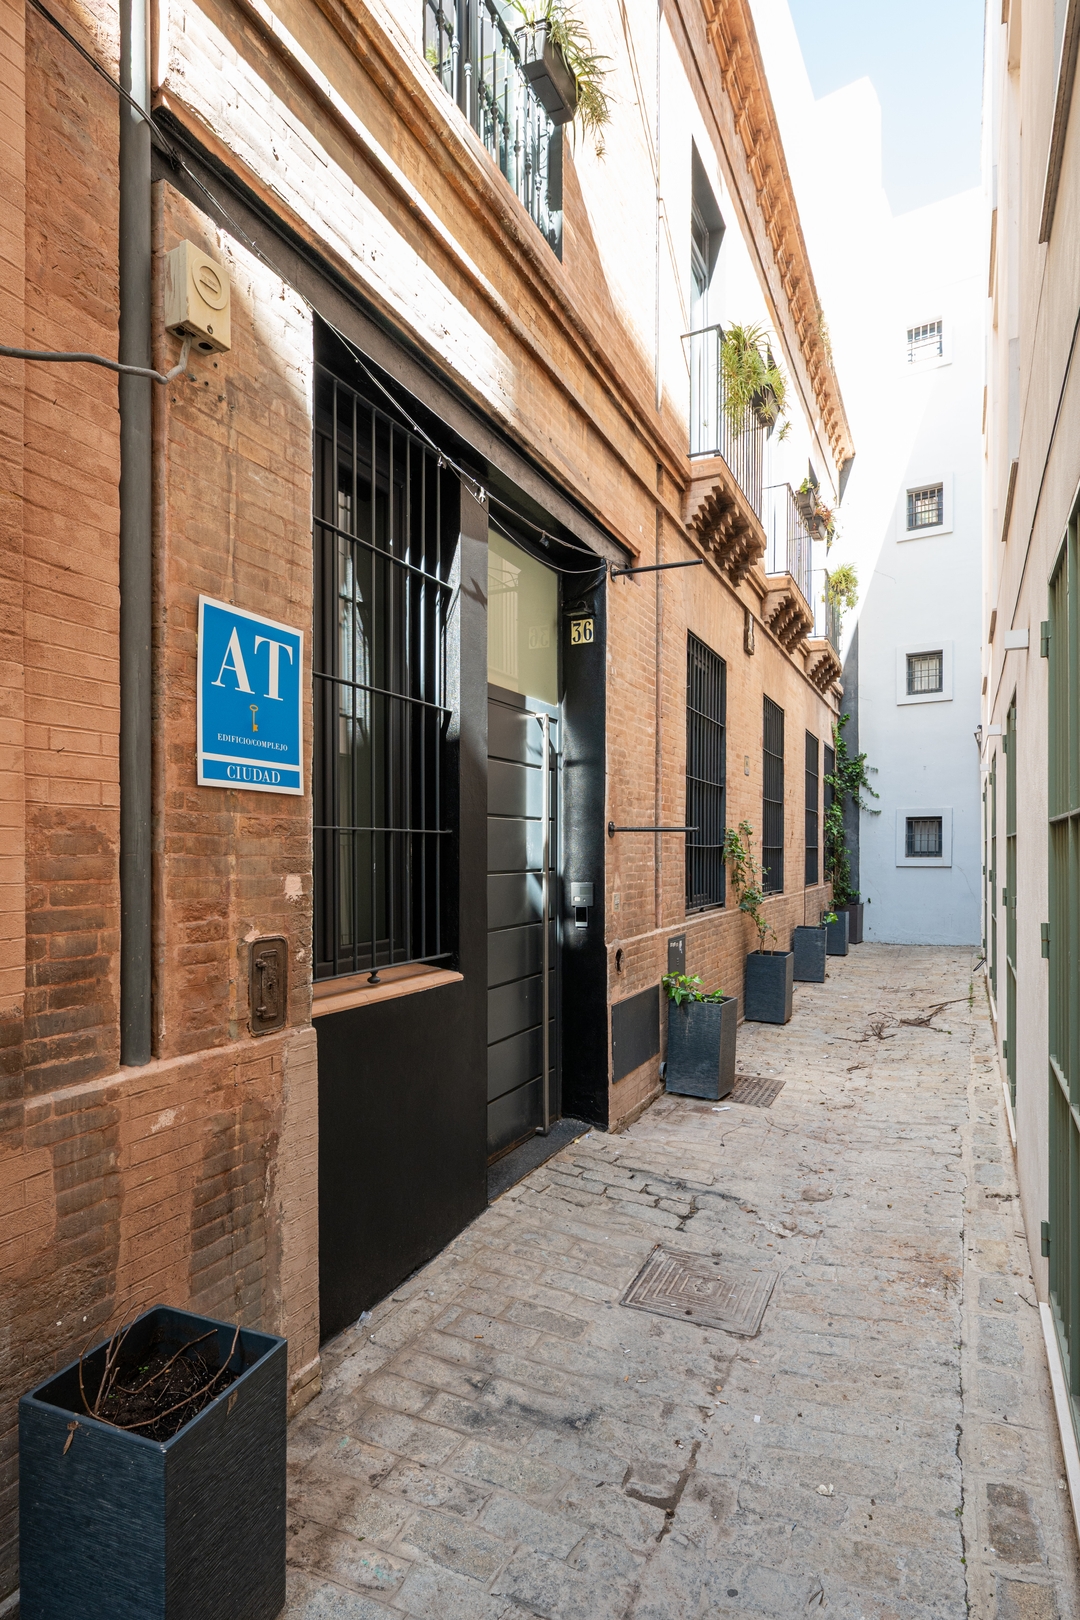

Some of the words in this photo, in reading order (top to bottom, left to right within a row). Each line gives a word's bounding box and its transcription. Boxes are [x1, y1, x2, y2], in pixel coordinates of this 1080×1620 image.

[573, 621, 593, 642] 36
[211, 626, 293, 701] AT
[217, 733, 288, 751] EDIFICIO/COMPLEJO
[226, 765, 280, 783] CIUDAD
